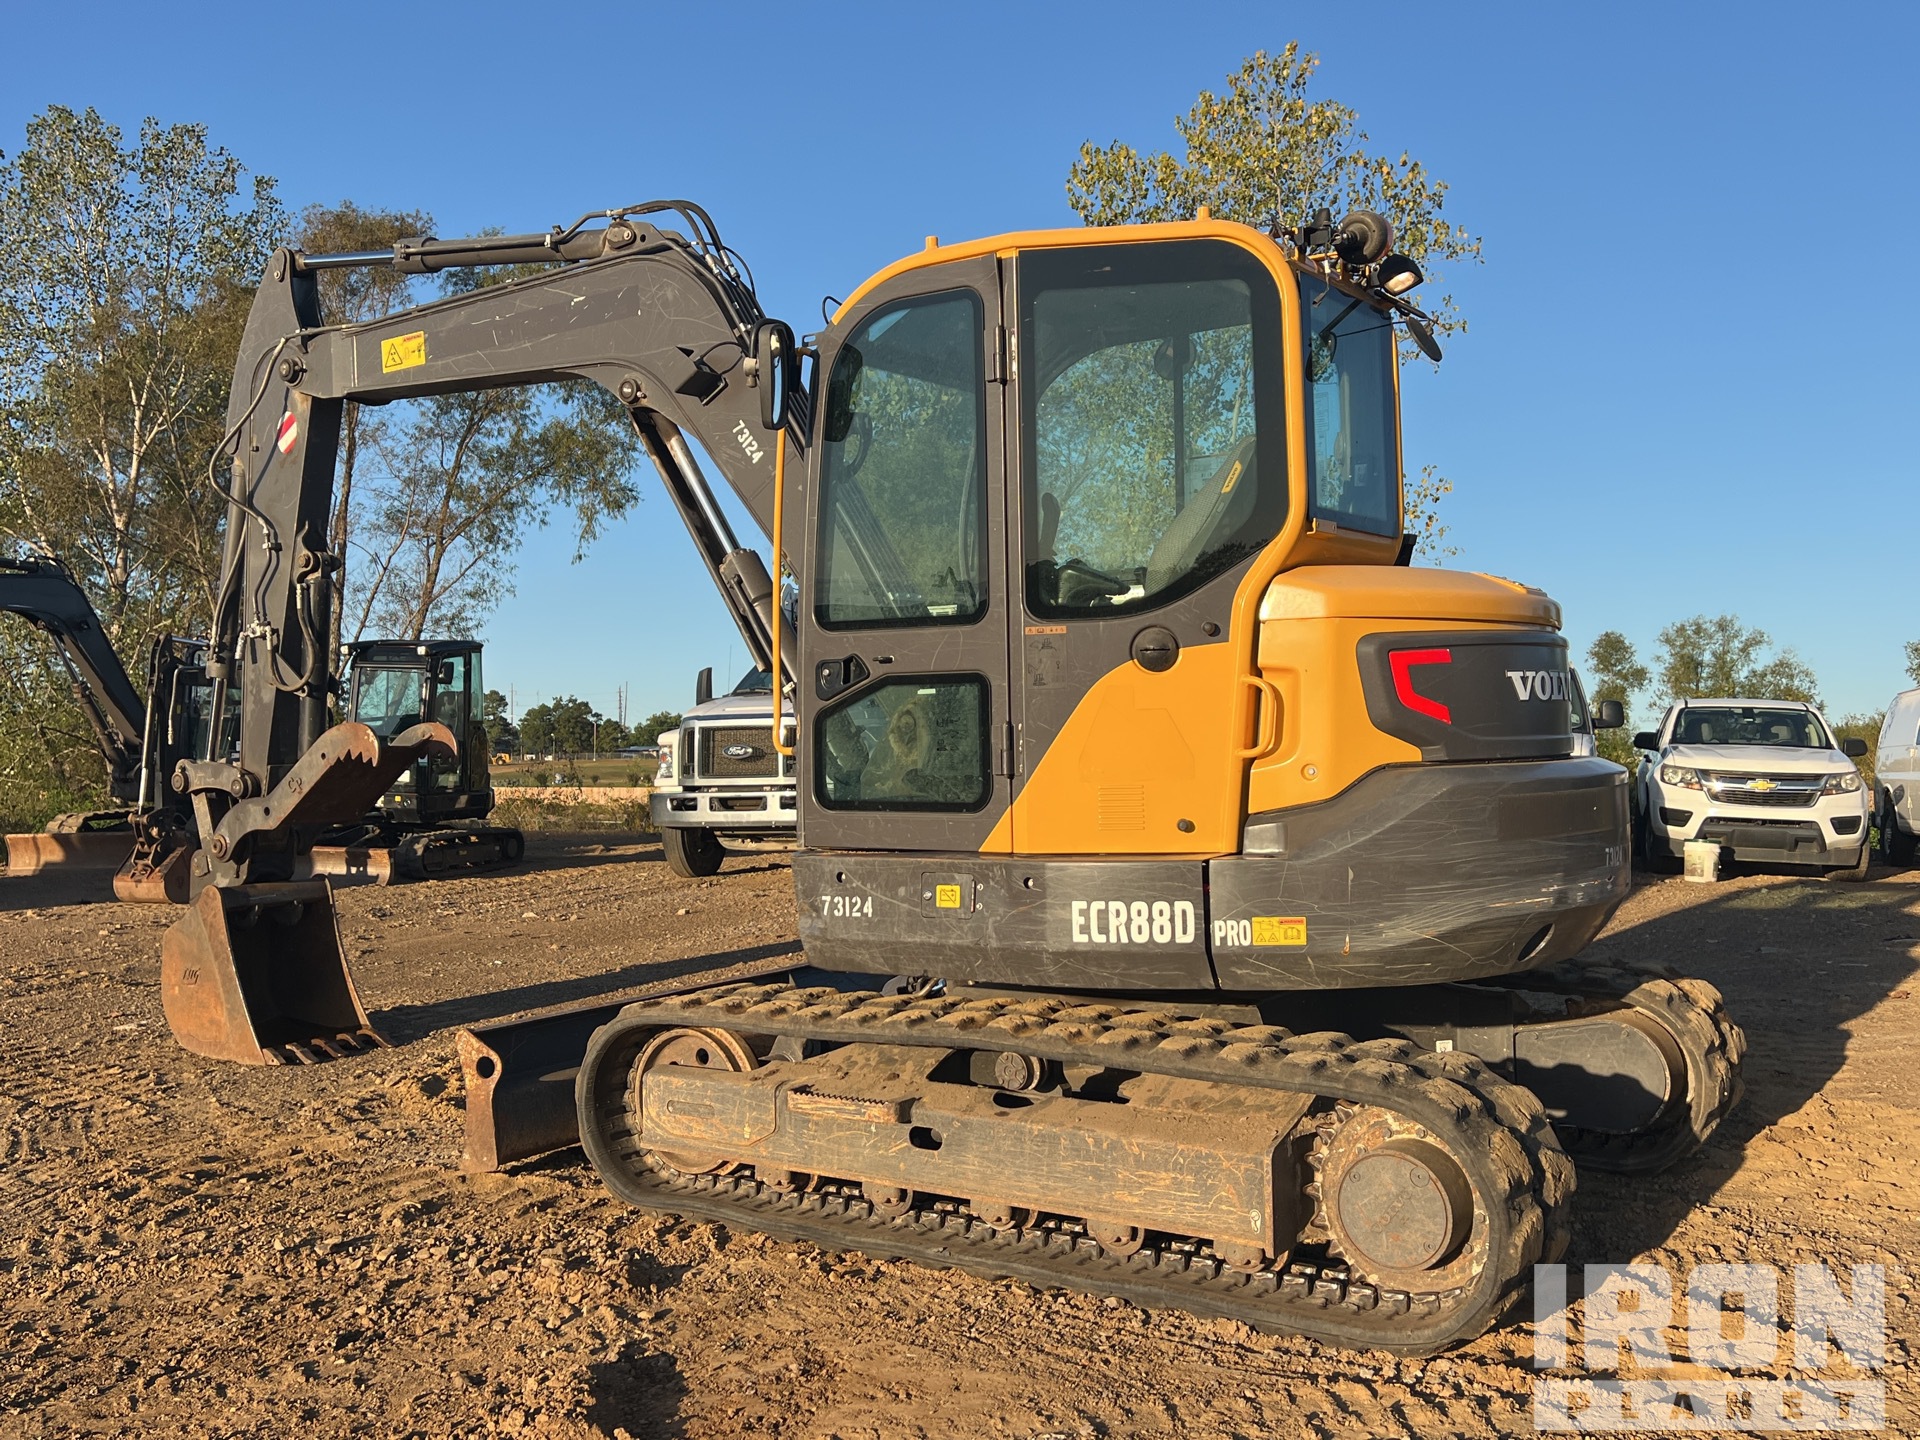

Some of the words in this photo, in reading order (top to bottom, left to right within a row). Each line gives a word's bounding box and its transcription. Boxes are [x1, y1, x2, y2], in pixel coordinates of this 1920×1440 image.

[732, 419, 764, 464] 73124
[1505, 670, 1571, 701] VOLV
[821, 895, 873, 917] 73124
[1071, 900, 1196, 944] ECR88D
[1213, 919, 1252, 946] PRO
